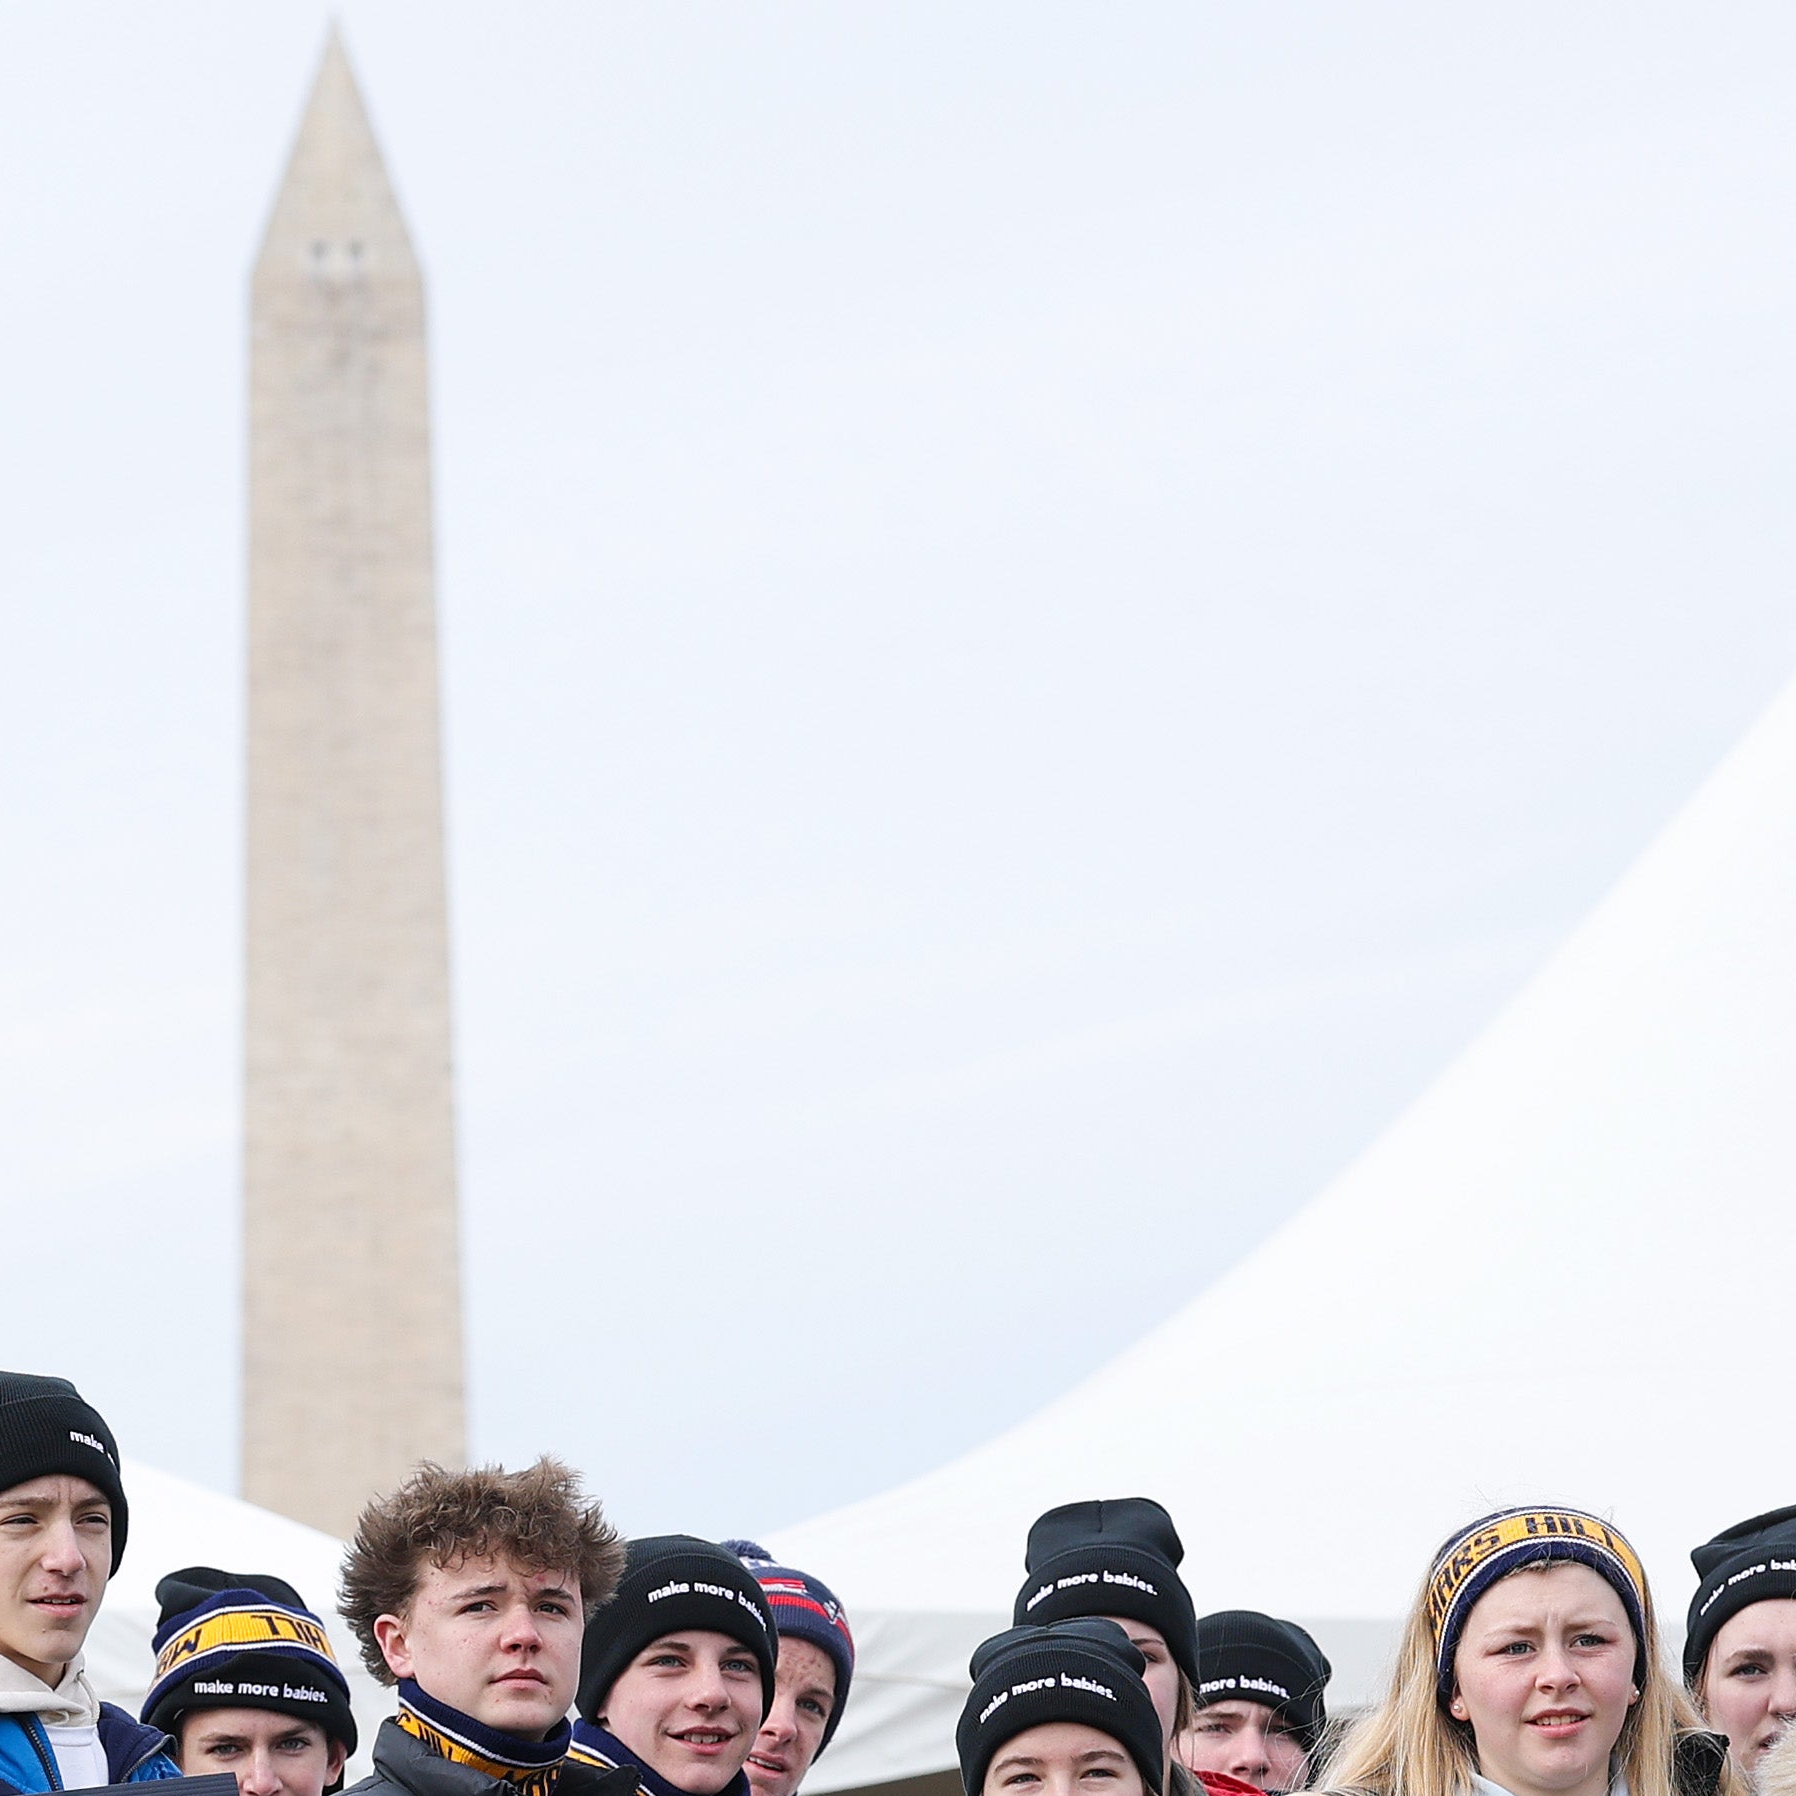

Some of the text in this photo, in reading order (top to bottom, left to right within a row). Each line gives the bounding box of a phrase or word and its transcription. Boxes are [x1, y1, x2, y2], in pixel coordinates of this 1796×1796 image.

[69, 1430, 105, 1453] make
[1057, 1571, 1099, 1590] more
[1103, 1571, 1159, 1596] babies.
[1728, 1563, 1767, 1586] more
[648, 1580, 690, 1603] make
[694, 1582, 734, 1600] more
[194, 1679, 329, 1704] make more babies.
[979, 1672, 1118, 1724] make more babies.
[1200, 1676, 1291, 1700] more babies.
